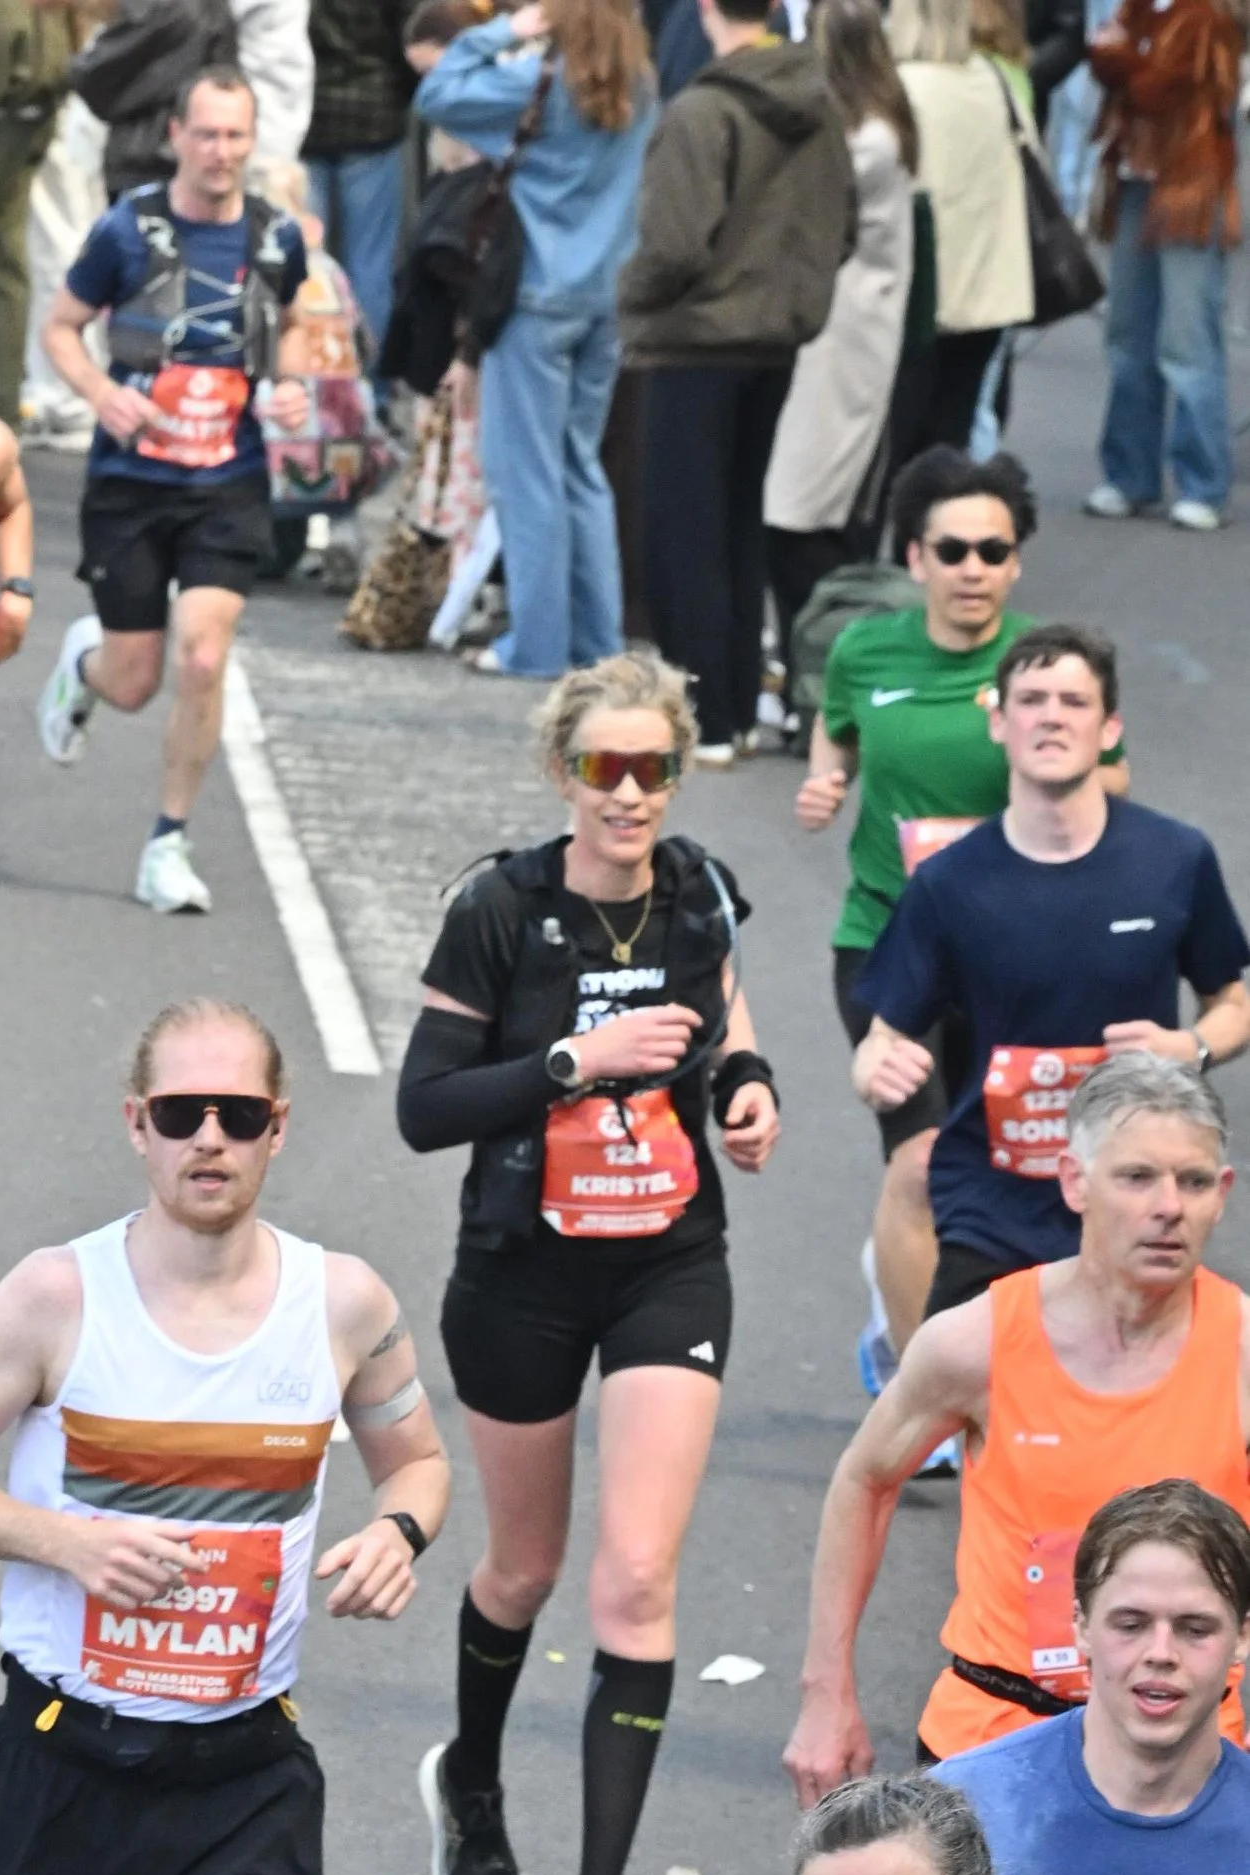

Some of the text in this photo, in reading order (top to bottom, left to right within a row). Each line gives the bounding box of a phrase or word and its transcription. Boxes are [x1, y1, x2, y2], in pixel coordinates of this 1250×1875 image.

[1001, 1118, 1069, 1143] SON
[604, 1141, 652, 1166] 124
[570, 1171, 678, 1196] KRISTEL
[198, 1548, 228, 1564] NN
[142, 1585, 238, 1614] 2997
[98, 1611, 258, 1656] MYLAN
